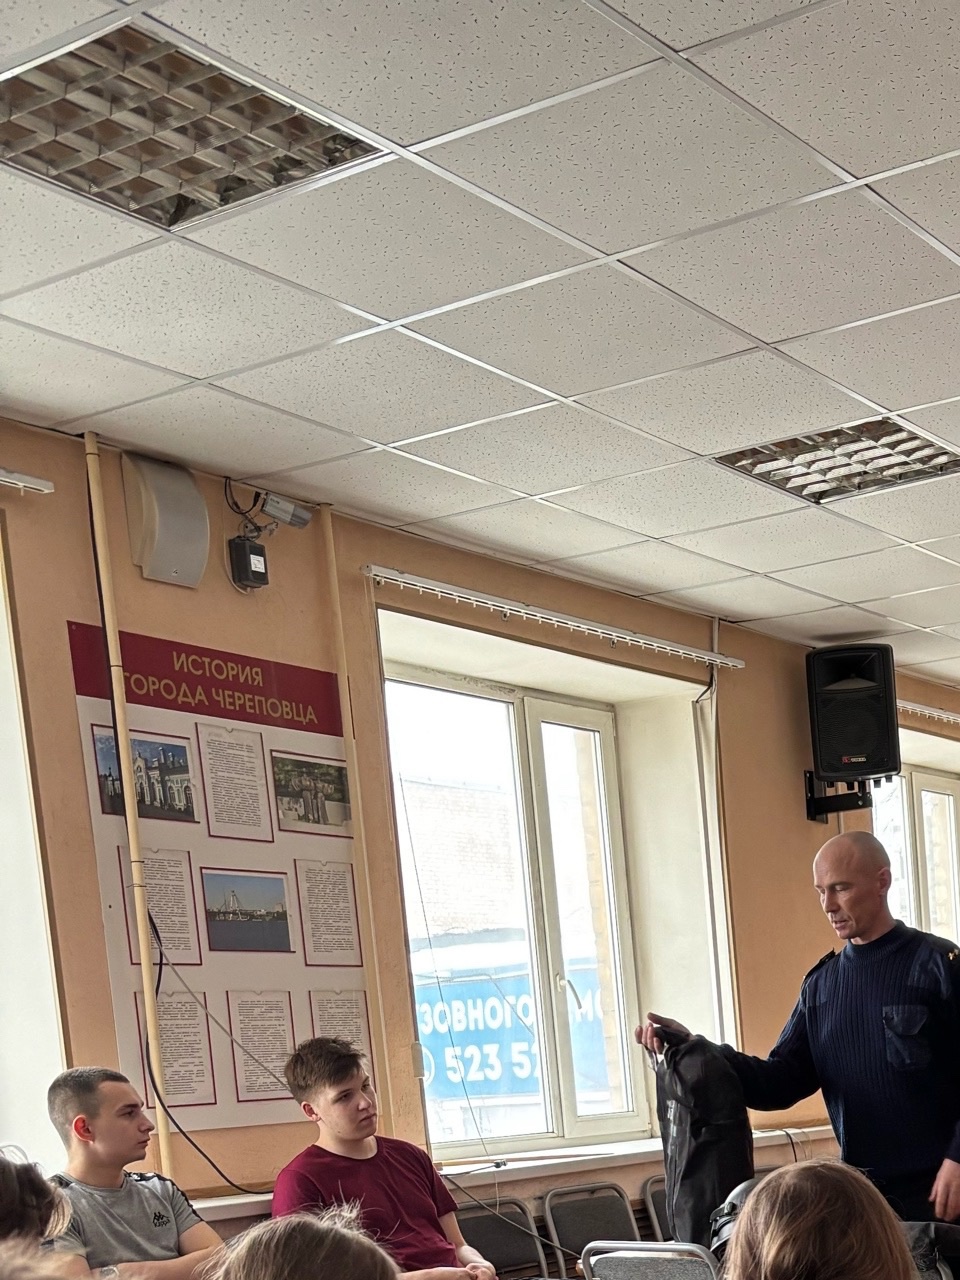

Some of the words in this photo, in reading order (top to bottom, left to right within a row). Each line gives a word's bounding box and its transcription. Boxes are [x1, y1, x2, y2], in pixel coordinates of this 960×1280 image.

[172, 651, 264, 687] ИСТОРИЯ
[212, 687, 318, 725] ЧЕРЕПОВЦА
[417, 994, 534, 1035] ЗОВНОГО
[444, 1043, 503, 1083] 523
